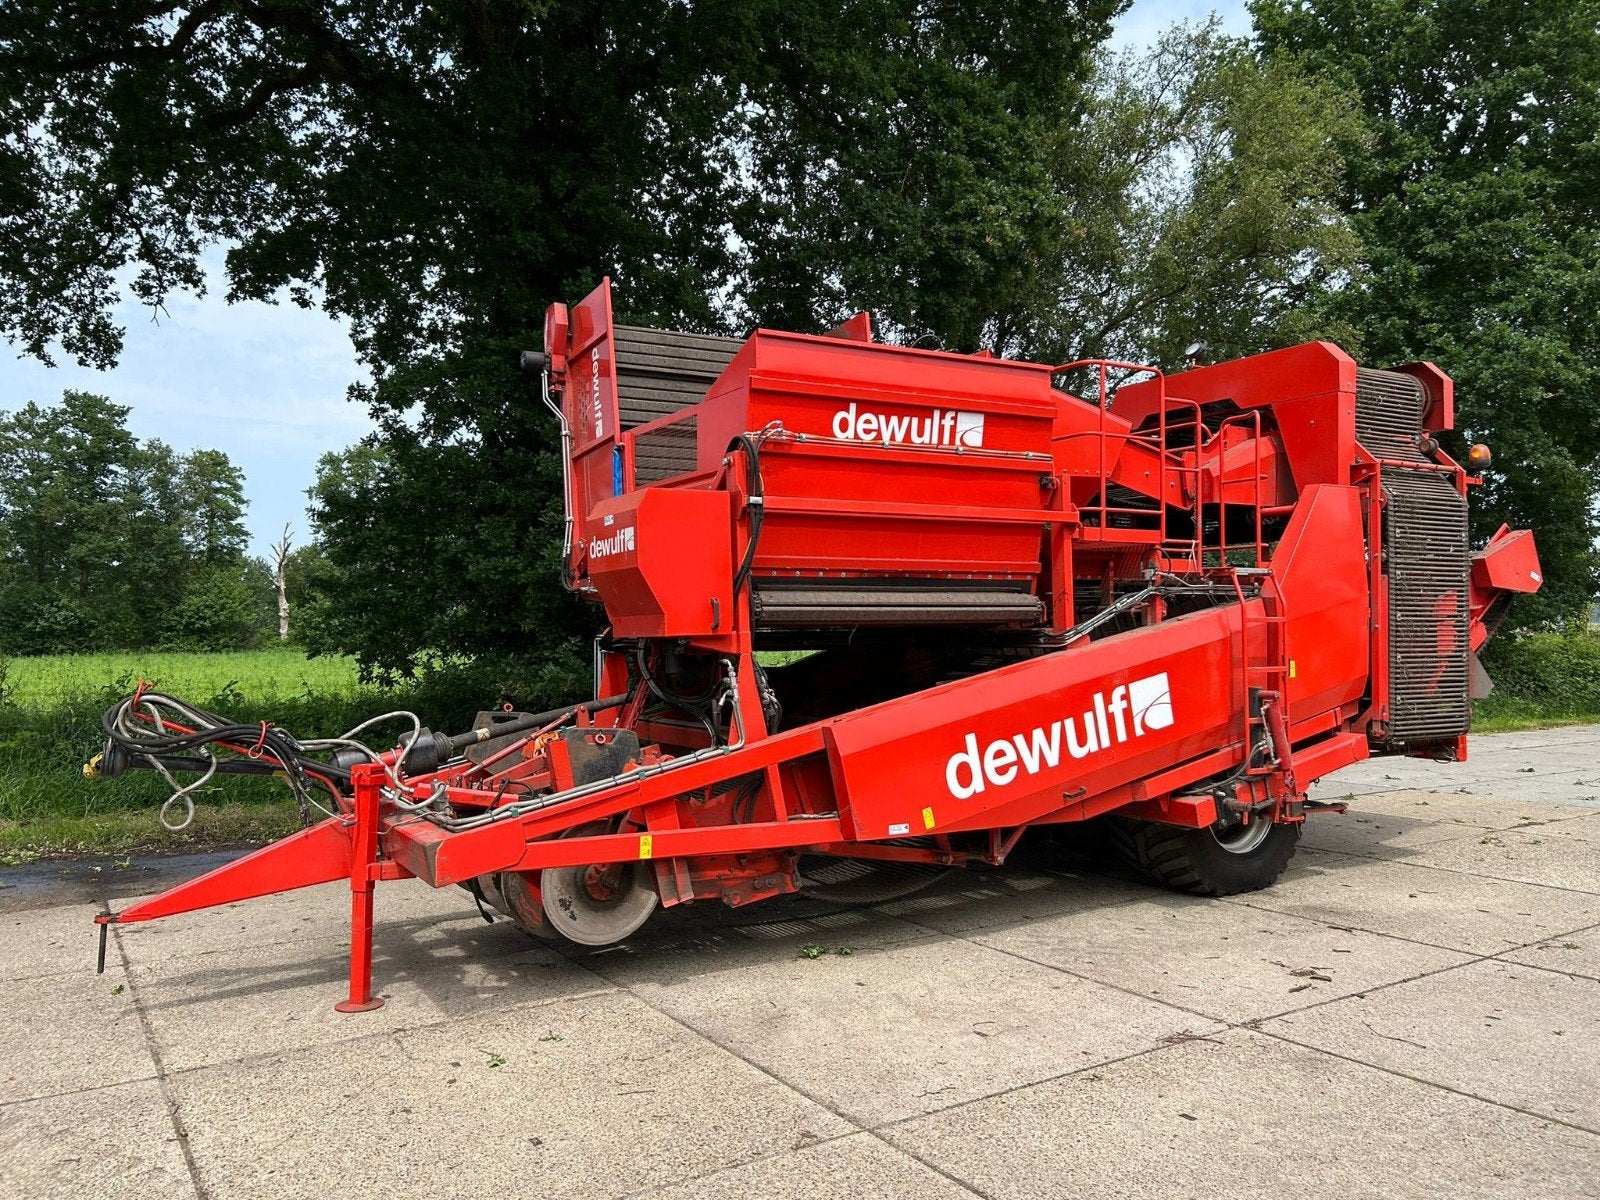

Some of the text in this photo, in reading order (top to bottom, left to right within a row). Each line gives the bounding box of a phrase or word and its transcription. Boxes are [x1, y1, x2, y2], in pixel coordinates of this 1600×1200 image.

[592, 347, 603, 419] dewulf
[832, 402, 956, 446] dewulf
[589, 529, 625, 559] dewulf
[945, 685, 1128, 799] dewulf
